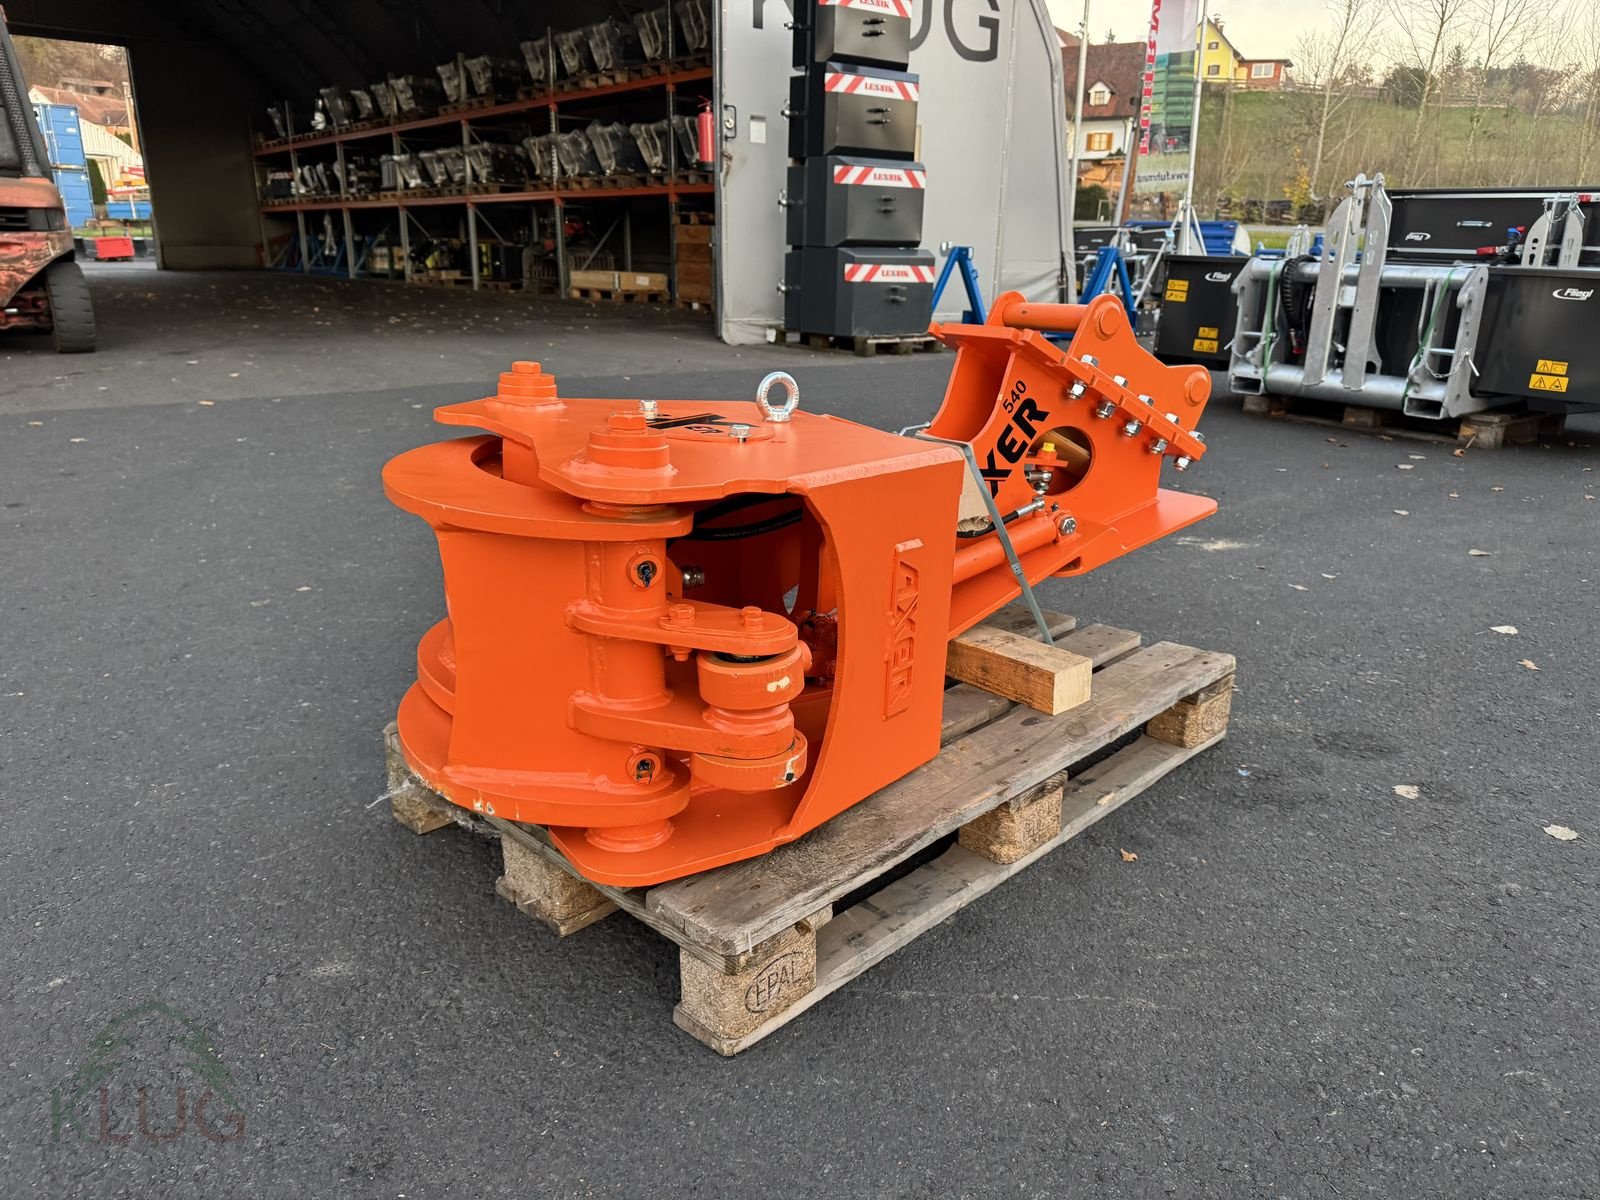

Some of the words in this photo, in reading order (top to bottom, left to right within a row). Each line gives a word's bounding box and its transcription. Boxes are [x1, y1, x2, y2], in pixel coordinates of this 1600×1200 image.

[1564, 288, 1594, 300] Fliegl
[1002, 380, 1027, 414] 540
[979, 398, 1050, 500] XER
[890, 561, 920, 709] AXER
[756, 961, 801, 1007] EPAL
